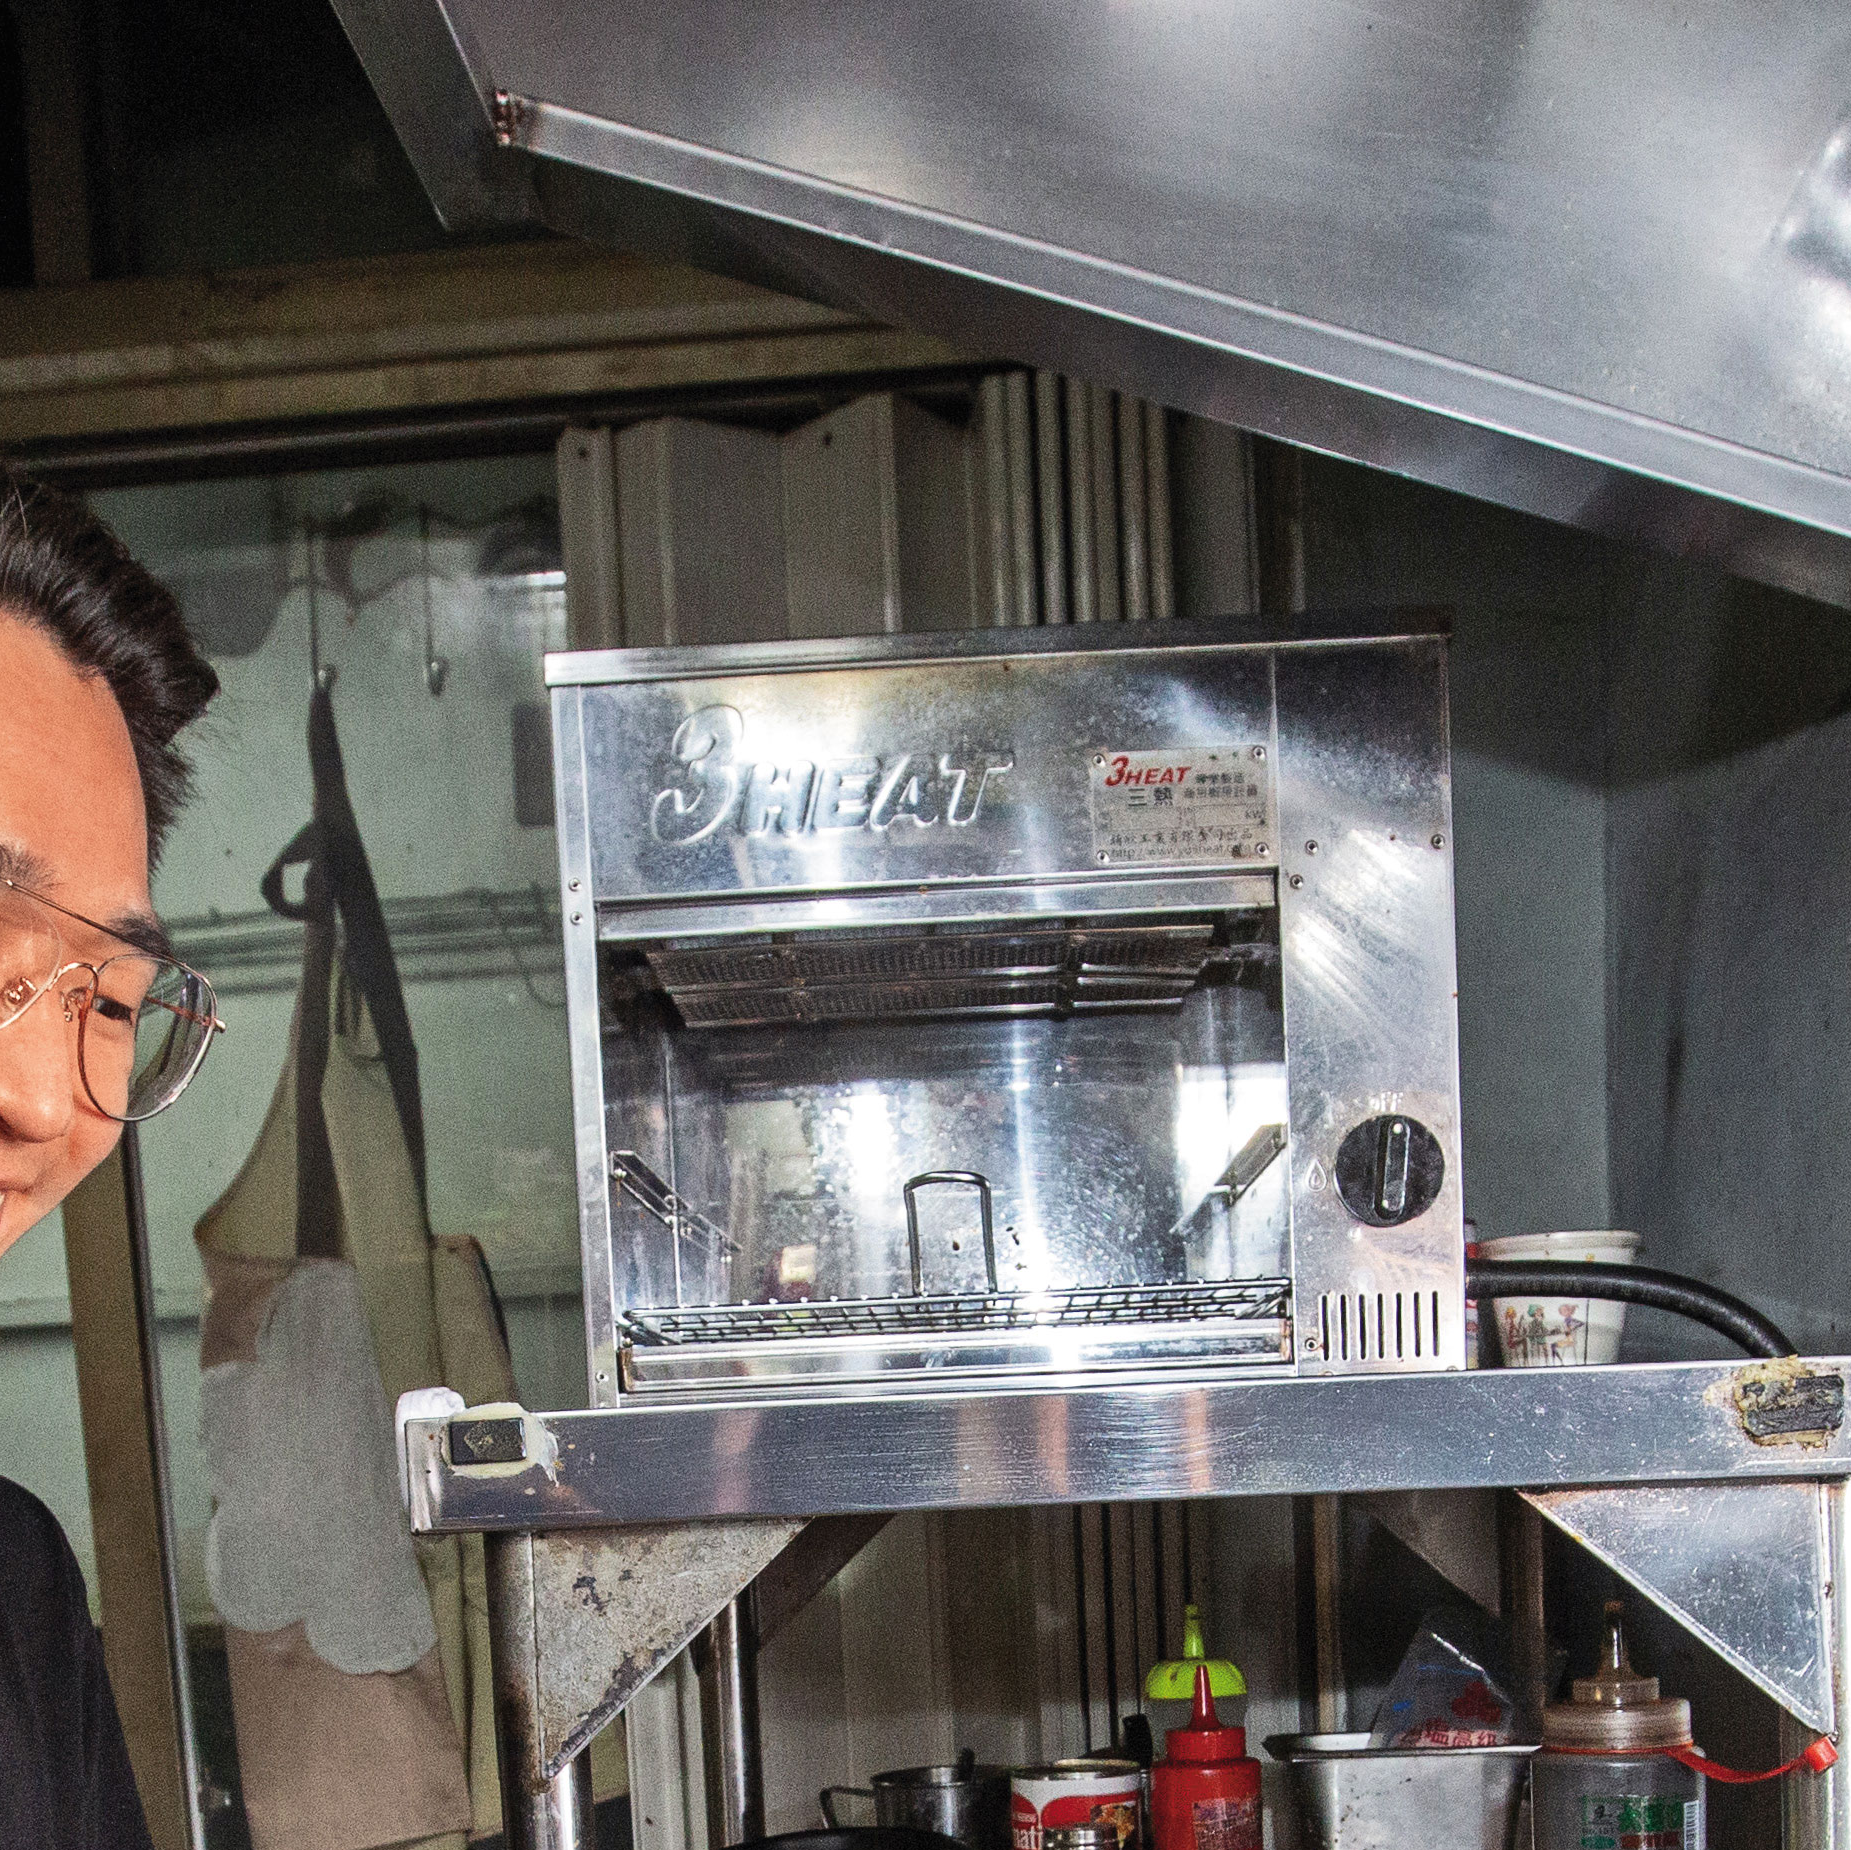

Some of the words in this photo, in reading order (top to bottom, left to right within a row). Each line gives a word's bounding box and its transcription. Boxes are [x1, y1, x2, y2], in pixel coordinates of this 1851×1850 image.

[653, 704, 1015, 845] 3HEAT
[1104, 755, 1191, 787] 3HEAT
[1128, 787, 1174, 807] 三熱
